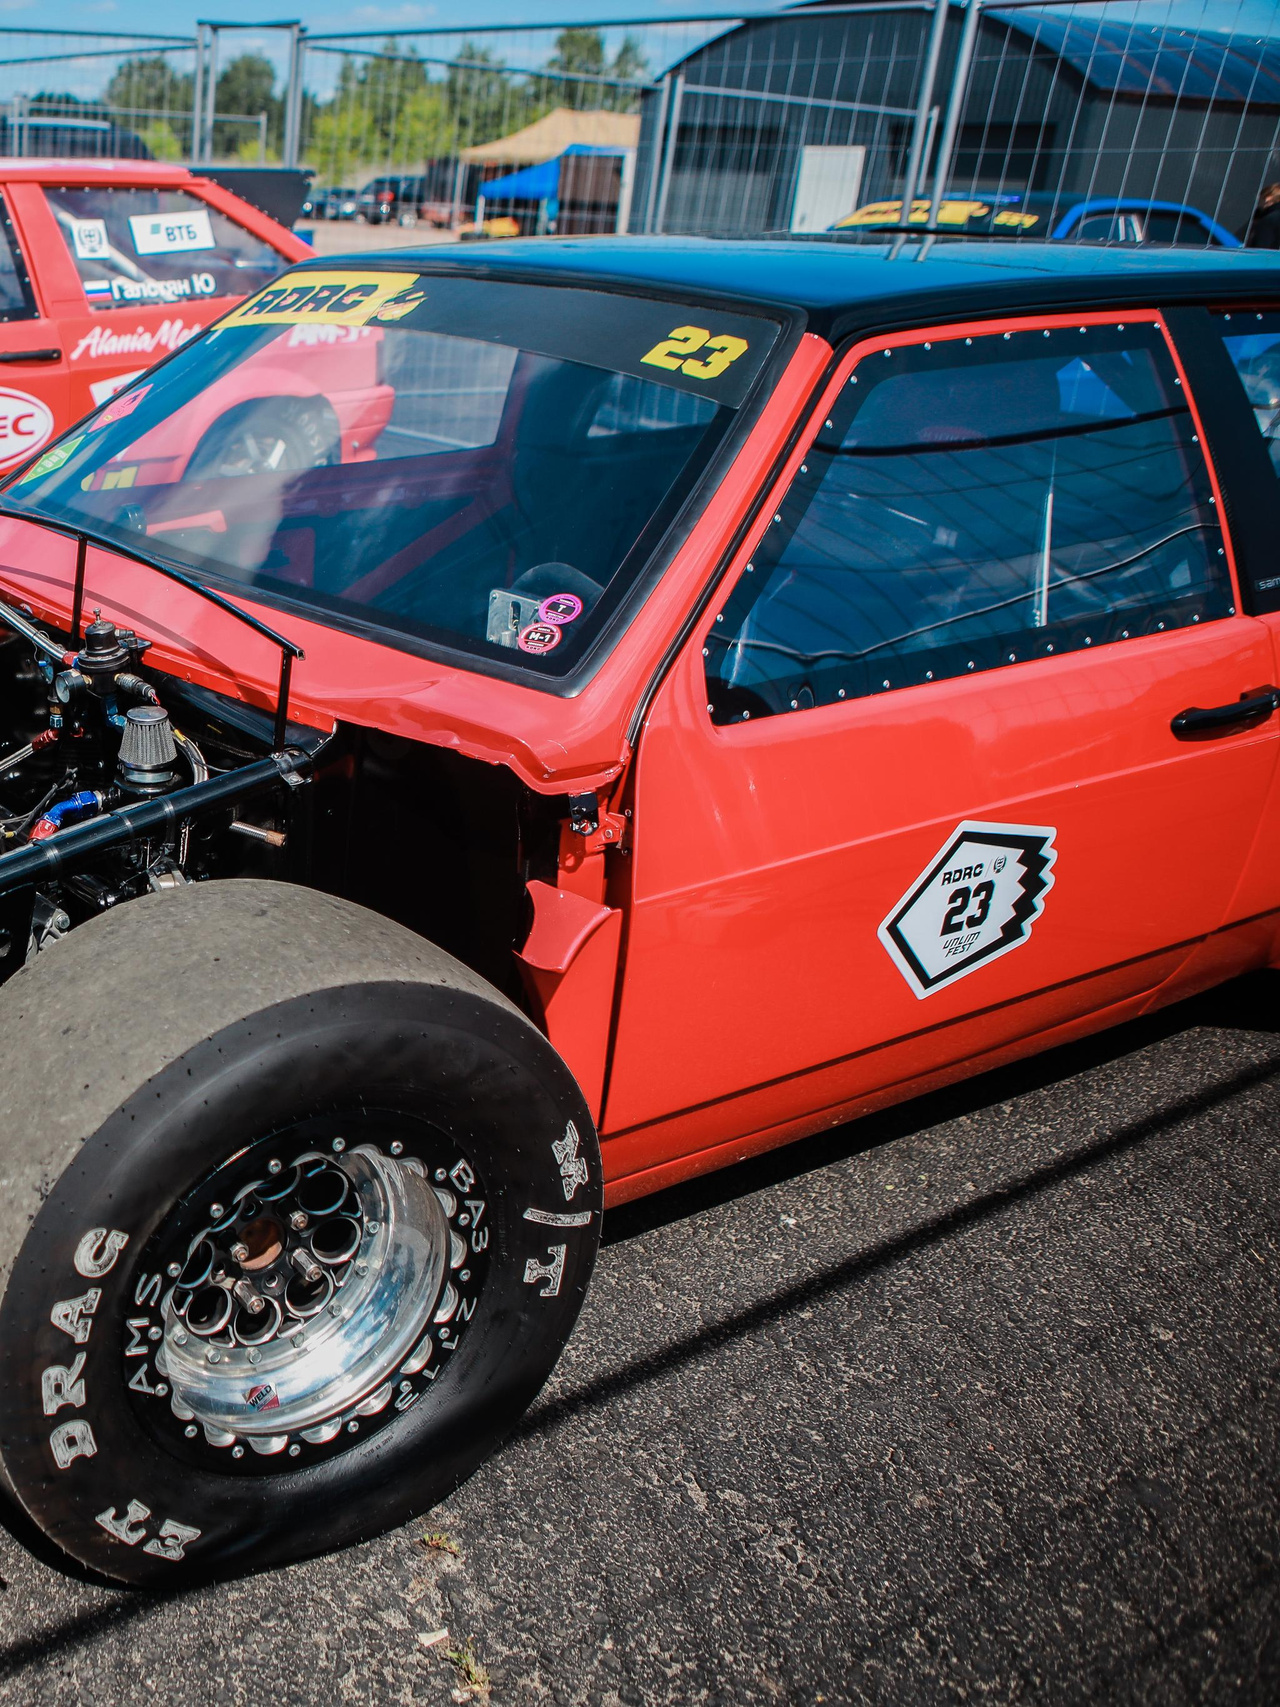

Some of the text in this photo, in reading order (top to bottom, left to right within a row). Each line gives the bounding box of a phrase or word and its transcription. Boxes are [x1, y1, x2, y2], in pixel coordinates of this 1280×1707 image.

[165, 226, 197, 243] ВТБ
[190, 272, 217, 295] Ю
[239, 284, 379, 317] RDRC
[639, 325, 749, 380] 23
[557, 604, 567, 613] T
[528, 631, 552, 643] M-1
[941, 862, 985, 886] RDRC
[939, 879, 996, 937] 23
[943, 931, 981, 950] UNLIM
[945, 943, 974, 958] FEST
[125, 1272, 162, 1395] AMS
[41, 1227, 202, 1561] ET DRAG
[248, 1384, 273, 1408] WELD
